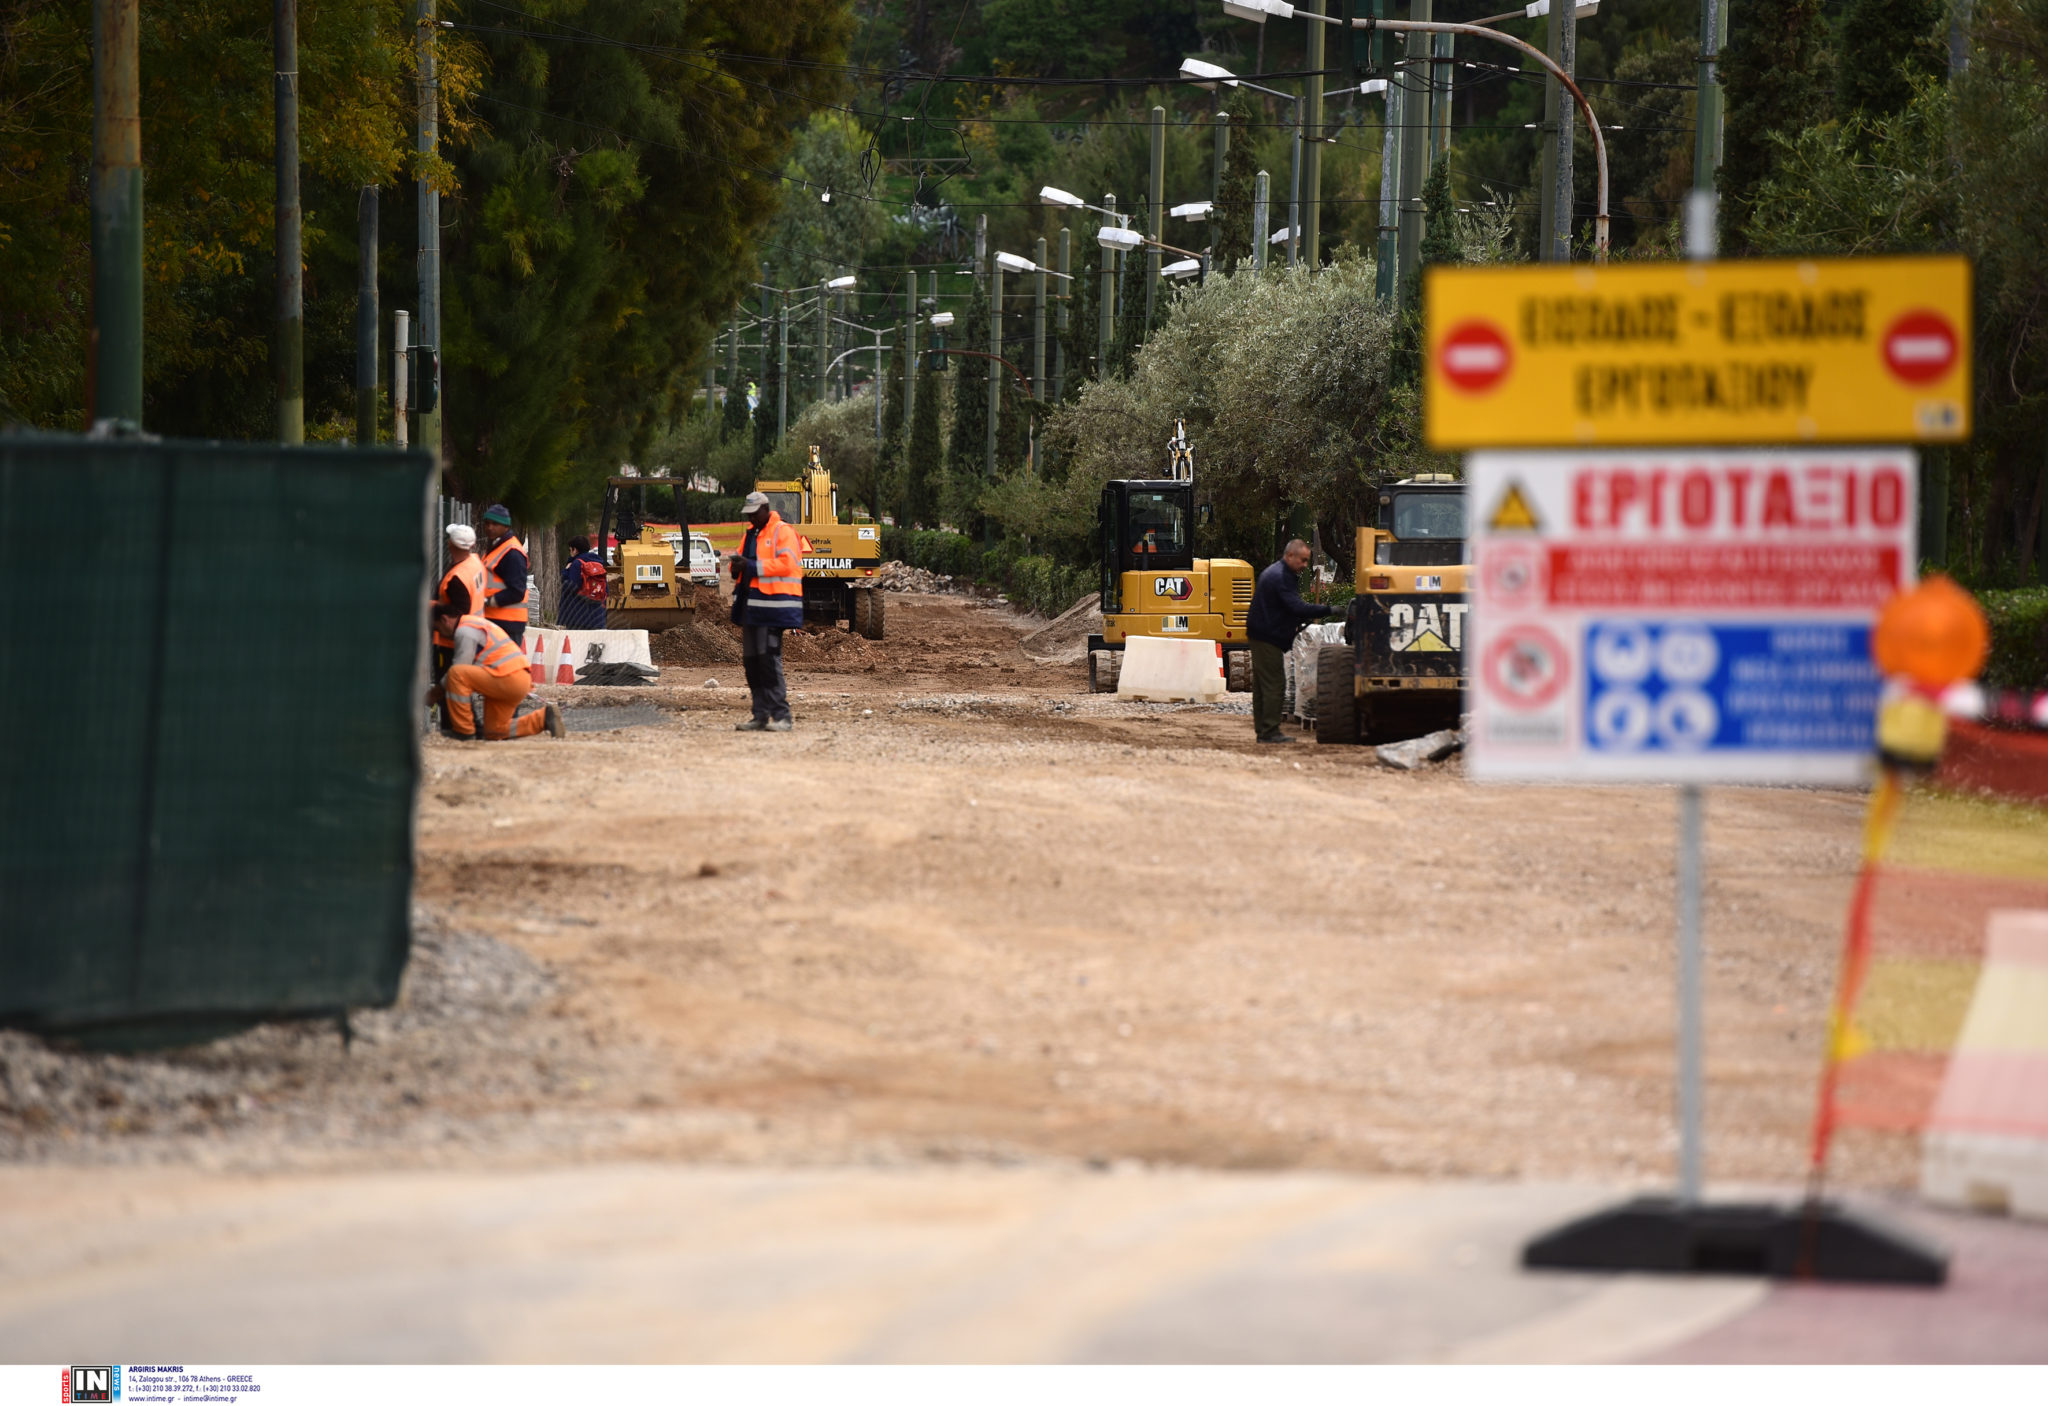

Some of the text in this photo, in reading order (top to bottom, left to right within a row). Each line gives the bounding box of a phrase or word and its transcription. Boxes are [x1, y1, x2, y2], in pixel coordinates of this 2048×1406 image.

[1573, 361, 1815, 416] ΕΡΓΟΤΑΞΙΟΥ
[1570, 464, 1906, 531] ΕΡΓΟΤΑΞΙΟ
[800, 558, 852, 569] TERPILLAR
[1155, 577, 1184, 596] CAT
[1389, 603, 1468, 651] CAT
